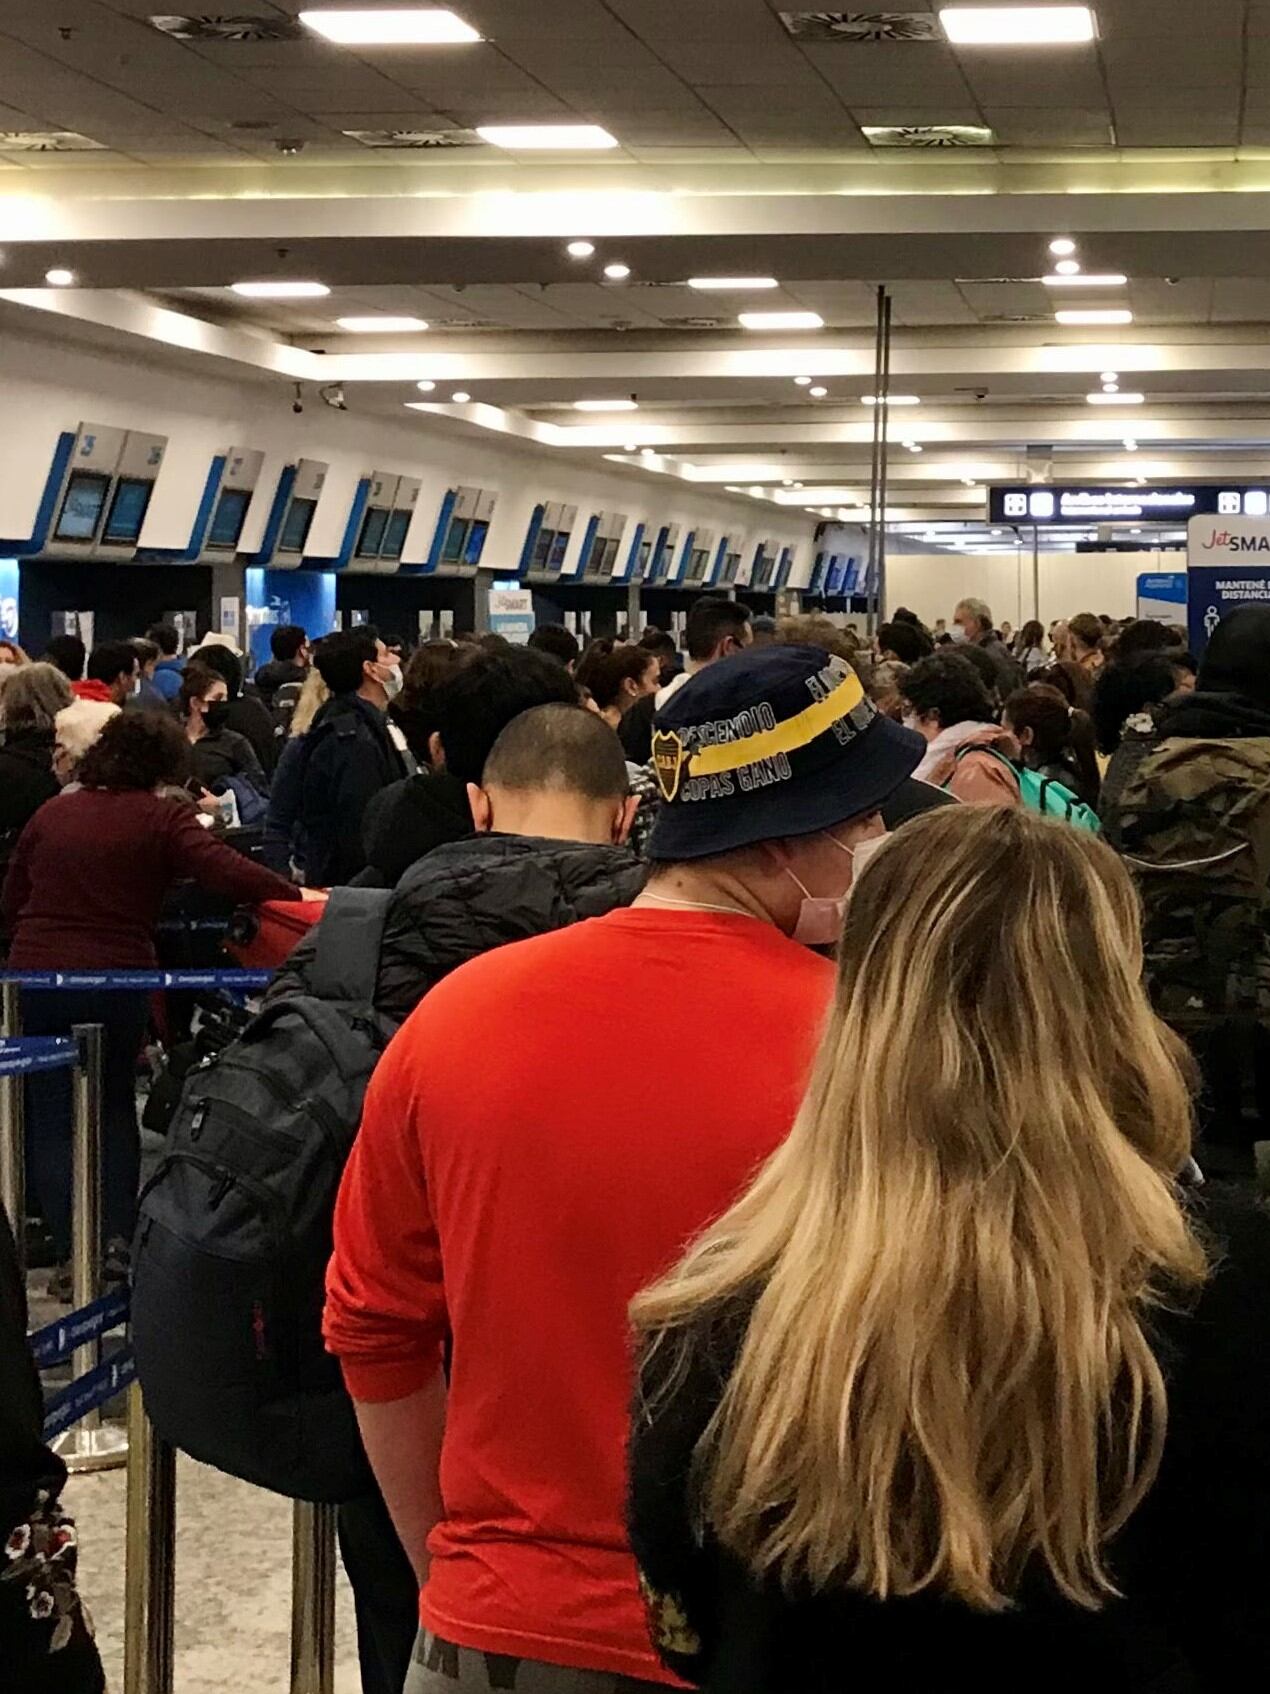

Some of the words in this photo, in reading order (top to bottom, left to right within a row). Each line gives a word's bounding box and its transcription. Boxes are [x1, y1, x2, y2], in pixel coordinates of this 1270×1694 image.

[1215, 580, 1265, 590] MANTENÉ
[681, 772, 735, 801] COPAS
[737, 752, 792, 791] GANO
